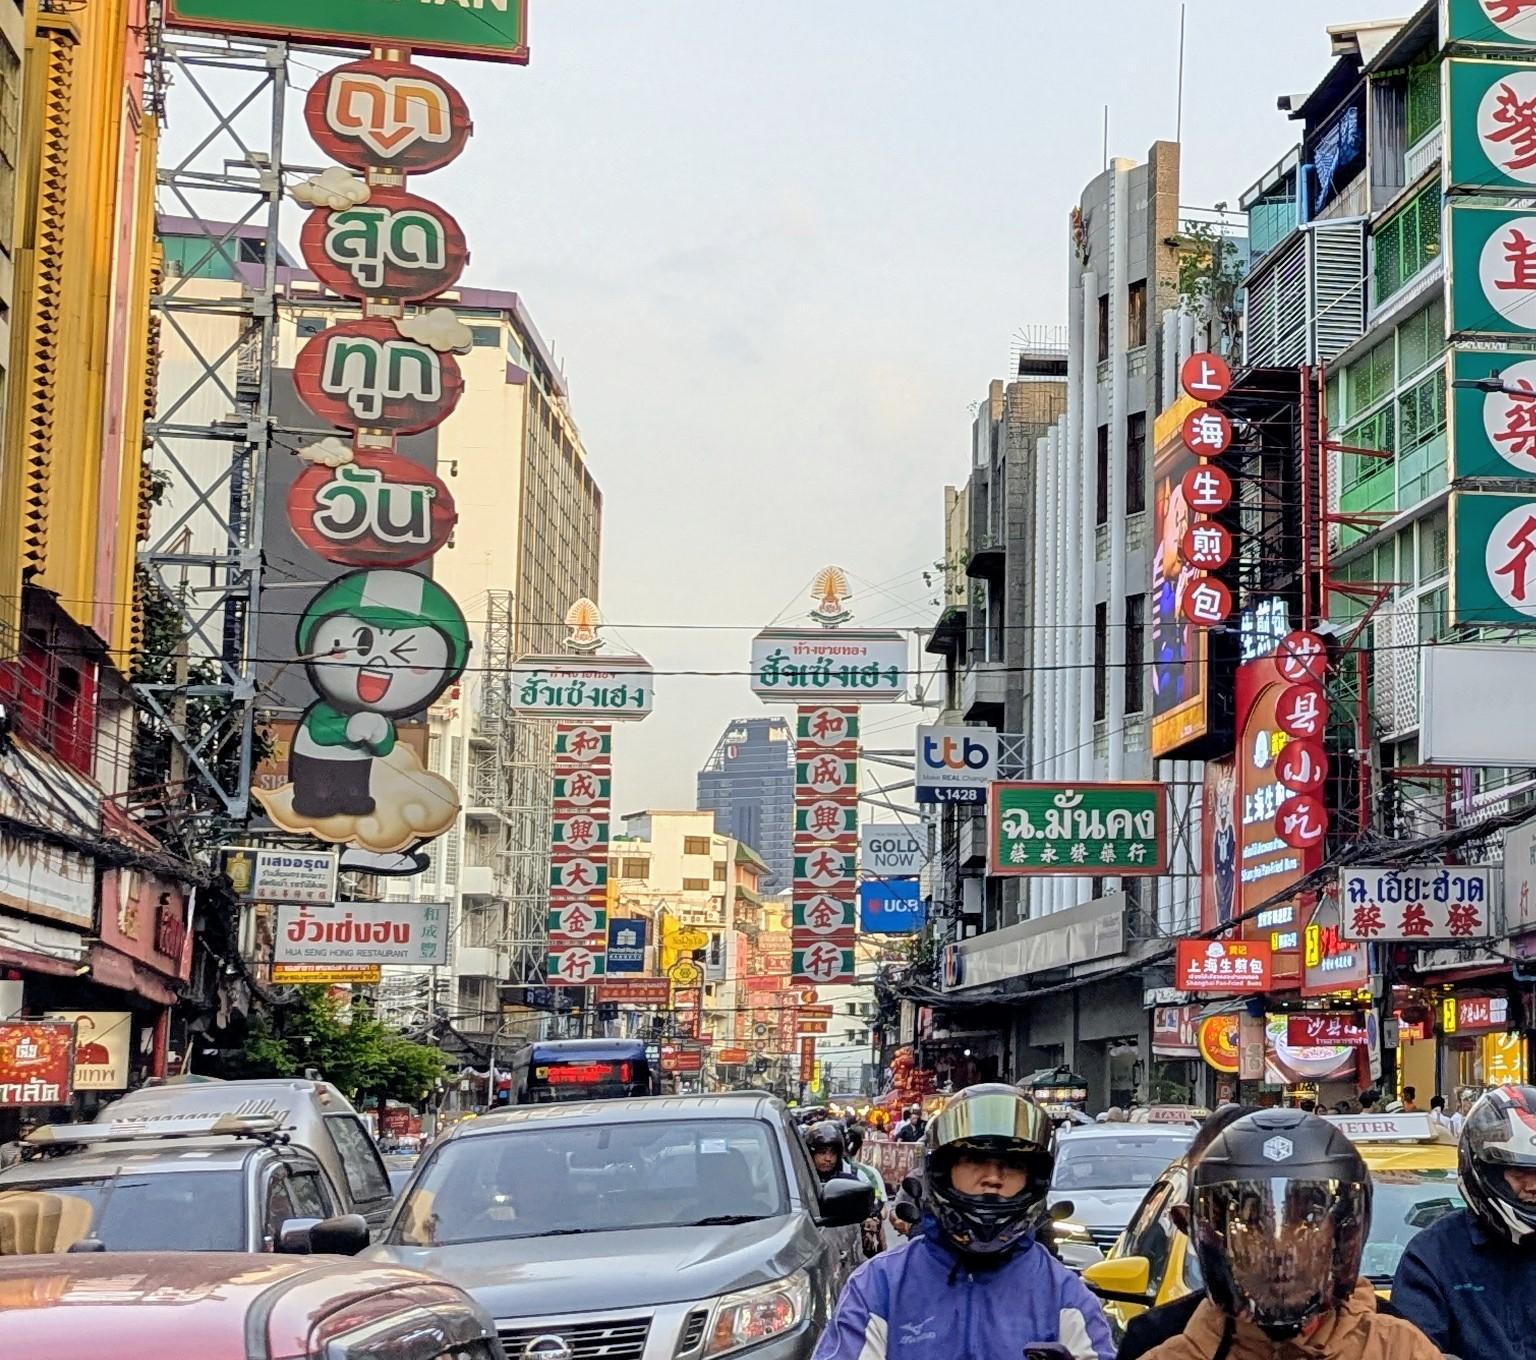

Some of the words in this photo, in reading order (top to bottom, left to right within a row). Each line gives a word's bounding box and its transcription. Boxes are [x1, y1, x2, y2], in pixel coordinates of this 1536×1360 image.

[332, 208, 439, 286] สุด
[330, 341, 435, 415] ทุก
[1189, 360, 1225, 621] 上海生煎包
[793, 641, 868, 657] ห้างขายทอง
[760, 649, 900, 689] ฮั่วเซ่งเฮง
[520, 673, 645, 709] ฮั่วเซ่งเฮง
[923, 735, 989, 770] ttb
[1284, 637, 1322, 839] 沙县小吃
[942, 774, 960, 782] REAL
[946, 789, 978, 801] 1428
[1001, 789, 1156, 840] ฉ.มั่นคง
[562, 730, 601, 979] 和成興大金行
[803, 707, 846, 976] 和成興大金行
[869, 839, 920, 853] GOLD
[261, 856, 330, 872] แสงอรุณ
[874, 853, 915, 867] NOW
[1348, 904, 1483, 938] 蔡益發
[285, 948, 302, 957] HUA
[304, 948, 328, 957] SENG
[329, 948, 354, 957] HONG
[356, 948, 409, 958] RESTAURANT
[1187, 958, 1264, 974] 上海生煎包
